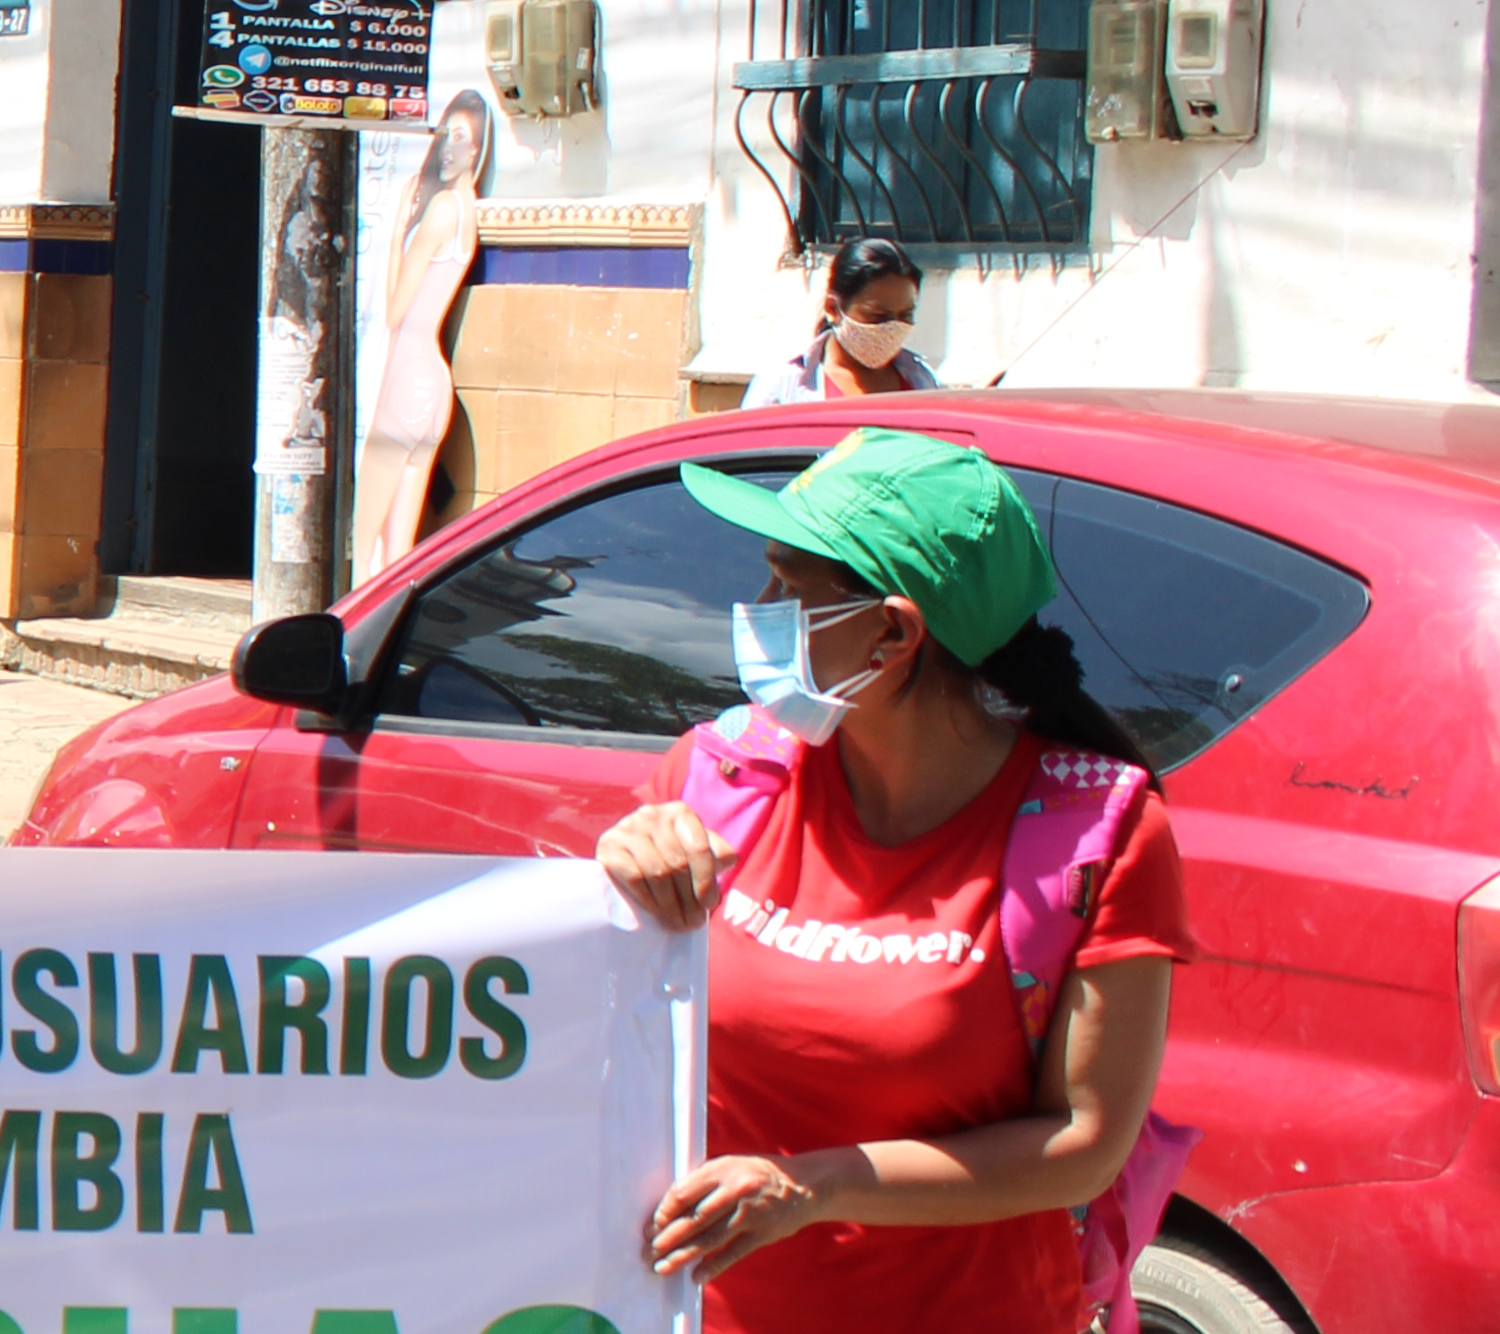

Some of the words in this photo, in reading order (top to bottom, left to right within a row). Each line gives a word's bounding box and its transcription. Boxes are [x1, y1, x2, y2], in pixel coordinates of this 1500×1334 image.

[209, 11, 237, 30] 1
[242, 15, 336, 30] PANTALLA
[367, 21, 427, 37] 6.000
[208, 30, 235, 49] 4
[237, 33, 341, 49] PANTALLAS
[362, 39, 428, 55] 15.000
[251, 75, 299, 91] 321
[303, 77, 350, 94] 653
[356, 80, 388, 97] 88
[393, 84, 425, 99] 75
